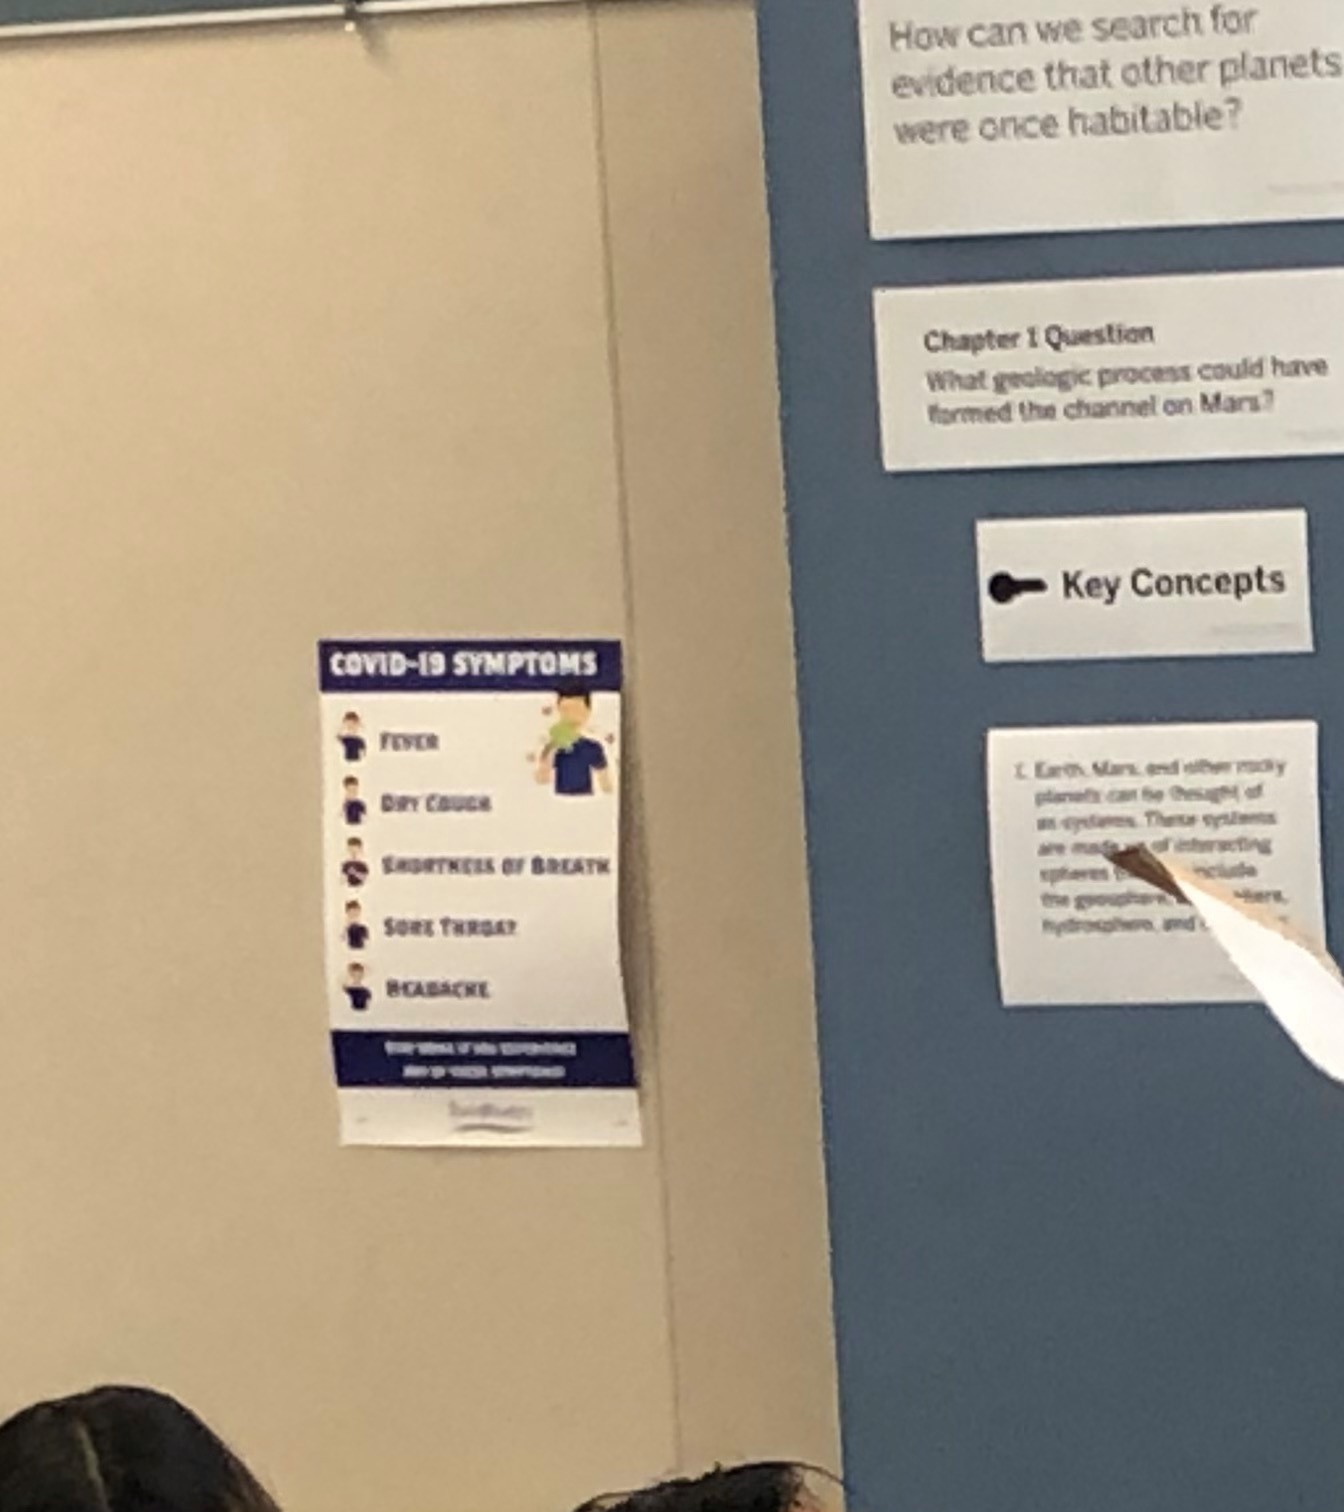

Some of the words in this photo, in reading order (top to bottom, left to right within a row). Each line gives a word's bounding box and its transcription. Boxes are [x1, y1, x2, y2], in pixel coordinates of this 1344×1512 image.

[889, 20, 959, 51] How
[967, 20, 1028, 48] can
[1038, 19, 1084, 43] we
[1092, 7, 1202, 42] search
[1210, 4, 1258, 36] for
[891, 64, 1035, 99] evidence
[1044, 60, 1112, 91] that
[1120, 54, 1207, 87] other
[1219, 48, 1344, 86] planets
[894, 116, 968, 145] were
[979, 112, 1060, 142] once
[1068, 96, 1244, 138] habitable?
[924, 329, 1021, 355] Chapter
[1026, 326, 1038, 349] 1
[1044, 323, 1155, 352] Question
[926, 367, 987, 392] What
[992, 363, 1091, 395] geologic
[1098, 362, 1192, 388] process
[1197, 356, 1265, 381] could
[1271, 354, 1329, 378] have
[927, 400, 1013, 425] formed
[1018, 399, 1057, 422] the
[1063, 393, 1157, 421] channel
[1162, 395, 1194, 416] on
[1199, 390, 1275, 415] Mars?
[1061, 569, 1122, 605] Key
[1130, 564, 1286, 600] Concepts
[329, 651, 446, 677] COVID-19
[452, 650, 598, 677] SYMPTOMS
[1145, 759, 1181, 777] and
[1106, 788, 1138, 803] can
